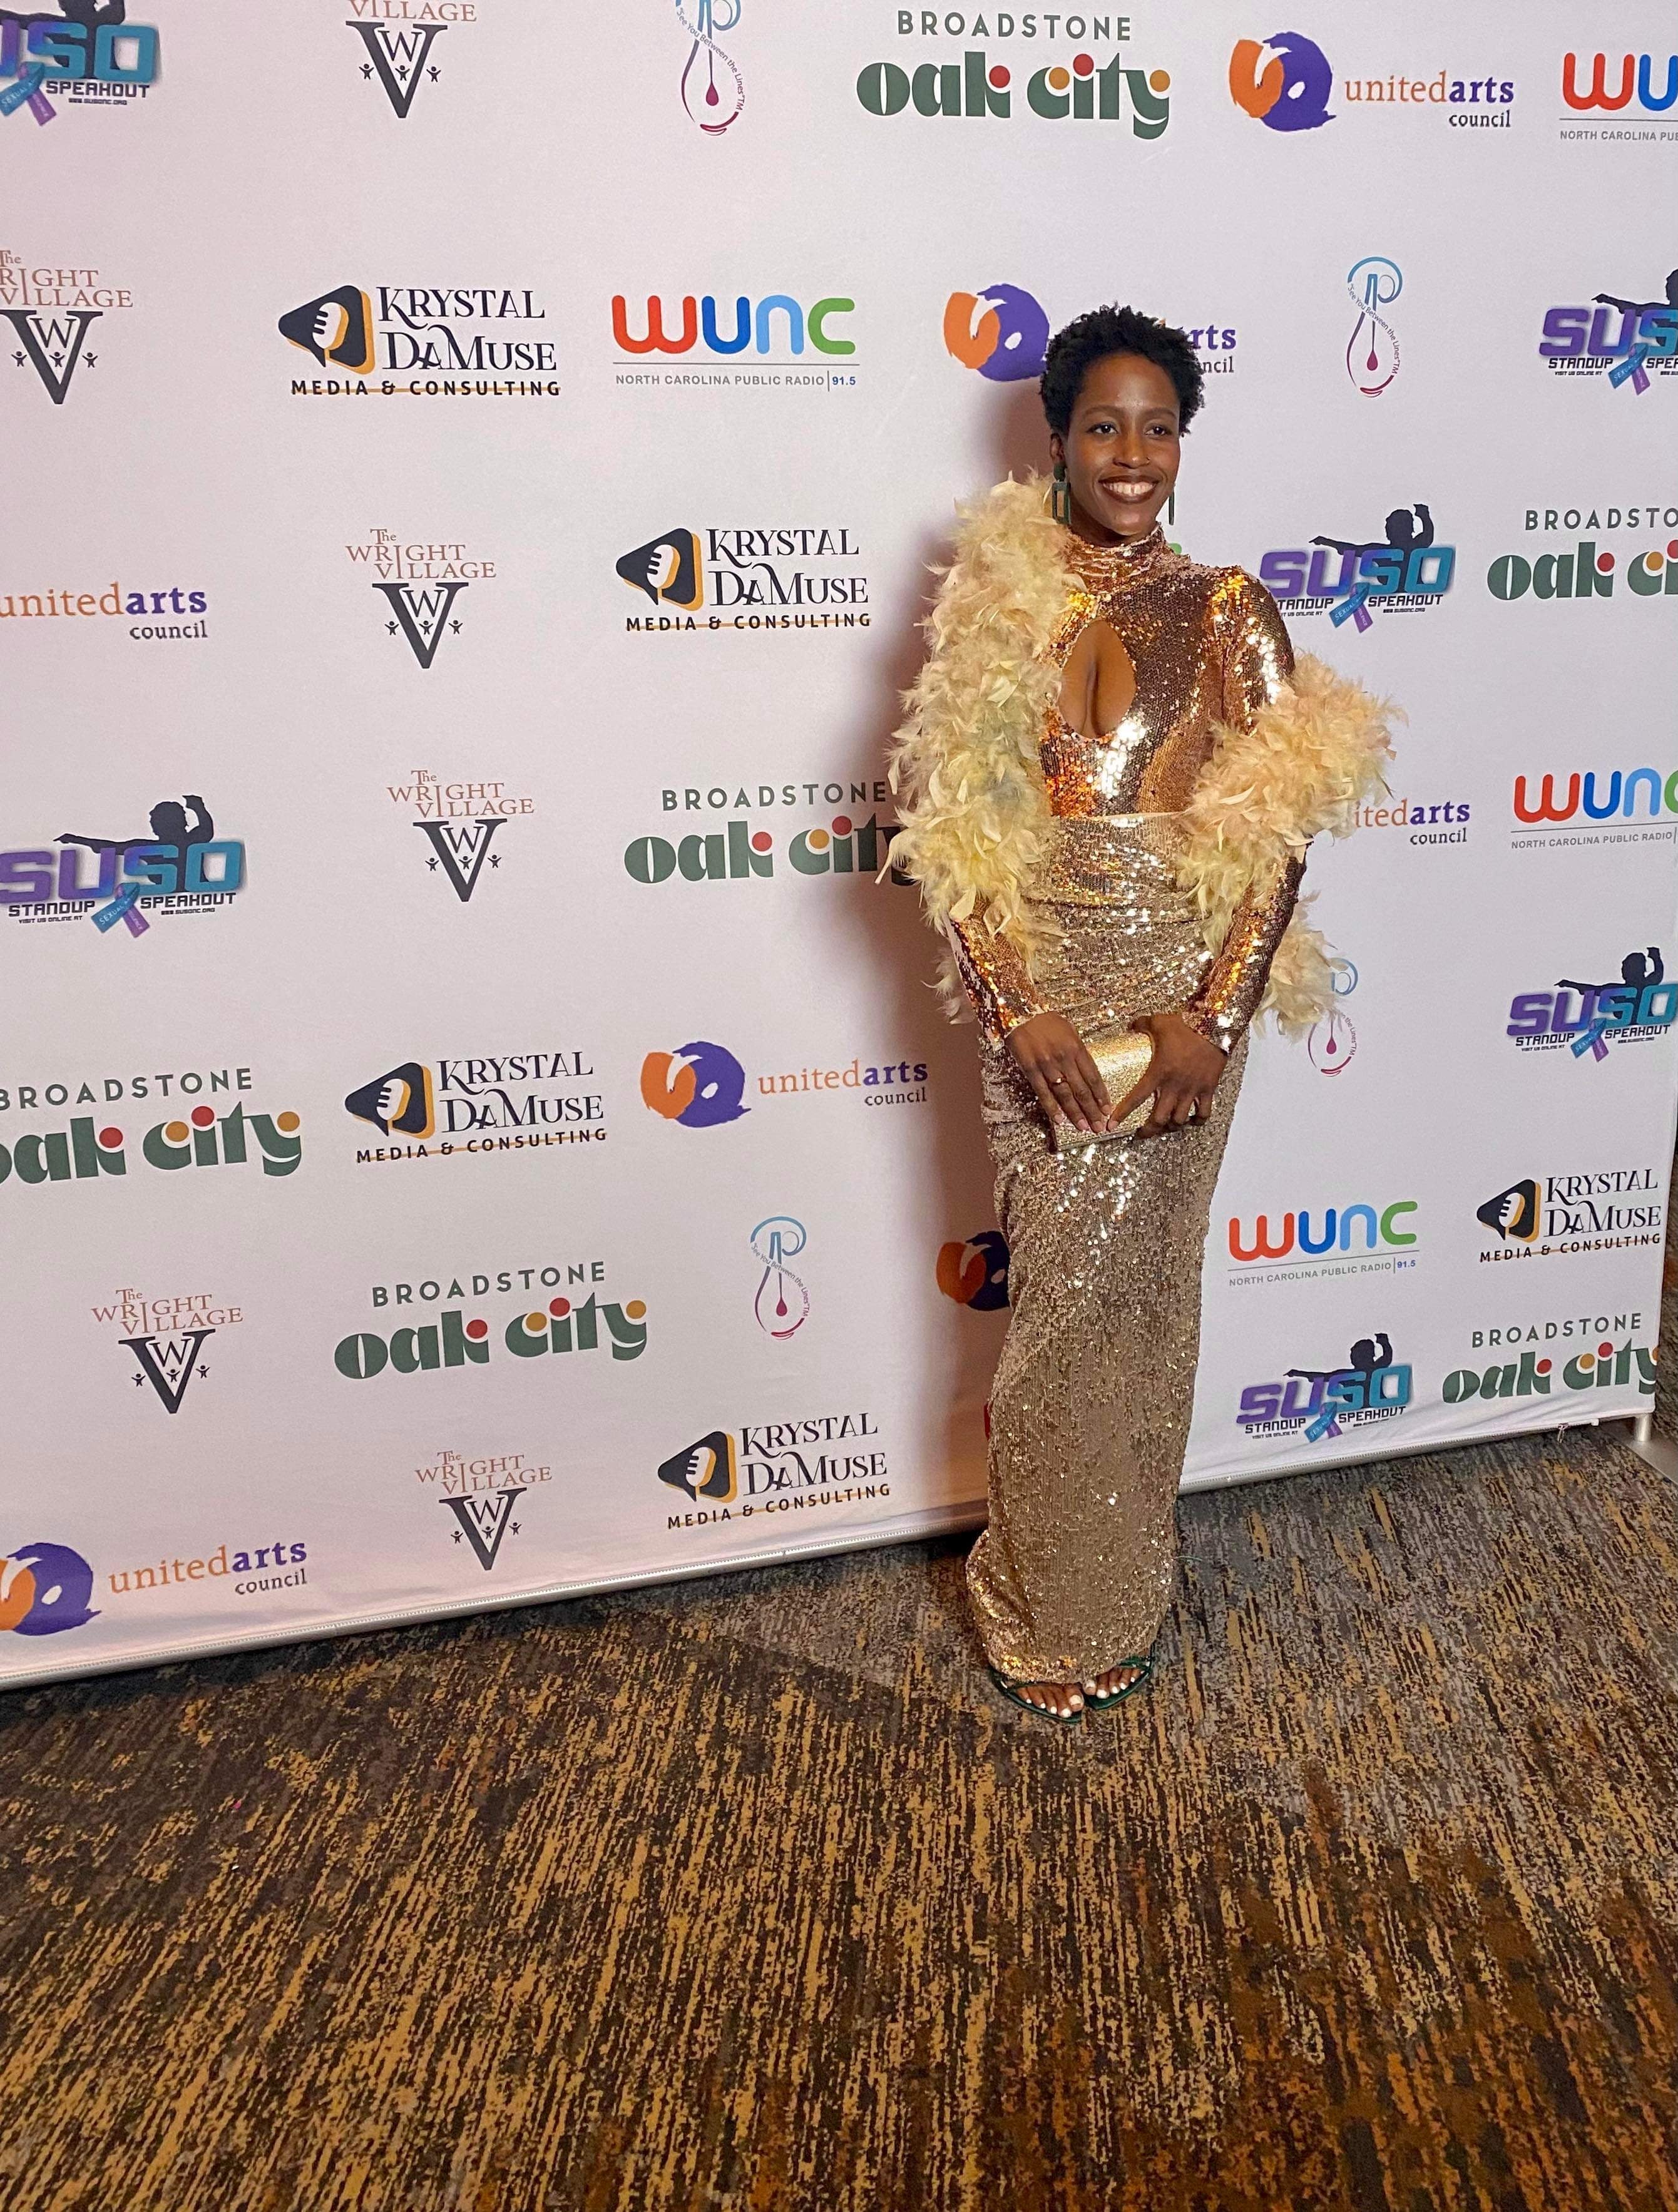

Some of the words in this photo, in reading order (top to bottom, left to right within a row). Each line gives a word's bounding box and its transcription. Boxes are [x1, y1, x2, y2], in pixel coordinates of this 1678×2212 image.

[350, 0, 477, 22] VILLAGE
[898, 9, 1131, 41] BROADSTONE
[687, 23, 700, 38] You
[700, 34, 729, 61] Between
[727, 59, 738, 73] the
[856, 51, 1011, 118] oak
[1026, 52, 1170, 140] city
[1448, 110, 1511, 128] council
[1560, 131, 1597, 141] NORTH
[1602, 131, 1656, 141] CAROLINA
[0, 287, 133, 307] VILLAGE
[376, 287, 545, 330] KRYSTAL
[1355, 297, 1365, 310] You
[1365, 306, 1389, 330] Between
[1387, 328, 1396, 341] the
[1548, 358, 1614, 369] STANDUP
[291, 380, 368, 396] MEDIA
[381, 381, 396, 394] &
[410, 380, 561, 396] CONSULTING
[616, 375, 660, 385] NORTH
[665, 376, 730, 385] CAROLINA
[735, 376, 781, 386] PUBLIC
[785, 376, 824, 386] RADIO
[832, 376, 856, 386] 91.5
[370, 529, 396, 545] The
[706, 529, 859, 568] KRYSTAL
[345, 545, 466, 562] WRIGHT
[374, 561, 496, 579] VILLAGE
[1260, 547, 1453, 597] SUSO
[1487, 541, 1615, 600] oak
[1277, 598, 1334, 611] TANDUP
[130, 620, 208, 640] council
[627, 617, 696, 631] MEDIA
[709, 616, 721, 630] &
[734, 613, 871, 629] CONSULTING
[386, 782, 504, 802] WRIGHT
[411, 770, 437, 786] The
[416, 798, 534, 818] VILLAGE
[662, 781, 886, 811] BROADSTONE
[1409, 827, 1467, 845] council
[1512, 839, 1545, 849] NORTH
[1549, 836, 1600, 847] CAROLINA
[1603, 834, 1639, 843] PUBLIC
[1642, 831, 1672, 841] RADIO
[624, 821, 773, 883] oak
[0, 841, 242, 904] SUSO
[9, 901, 95, 917] STANDUP
[1507, 983, 1678, 1036] SUSO
[1515, 1033, 1575, 1047] STANDUP
[1605, 1024, 1670, 1039] SPEAKOUT
[436, 1052, 593, 1095] KRYSTAL
[0, 1067, 252, 1111] BROADSTONE
[864, 1087, 928, 1106] council
[0, 1117, 126, 1184] ak
[143, 1101, 301, 1177] city
[356, 1144, 429, 1164] MEDIA
[441, 1142, 453, 1155] &
[467, 1128, 606, 1153] CONSULTING
[1545, 1169, 1659, 1206] KRYSTAL
[1480, 1247, 1532, 1263] MEDIA
[1541, 1245, 1550, 1256] &
[1560, 1233, 1660, 1254] CONSULTING
[372, 1261, 605, 1307] BROADSTONE
[1229, 1276, 1264, 1287] NORTH
[1267, 1271, 1317, 1283] CAROLINA
[1321, 1266, 1357, 1276] PUBLIC
[1361, 1262, 1391, 1272] RADIO
[1396, 1260, 1416, 1268] 91.5
[91, 1294, 212, 1323] WRIGHT
[116, 1288, 143, 1304] The
[120, 1308, 243, 1335] VILLAGE
[334, 1310, 490, 1379] oak
[504, 1292, 647, 1361] city
[1472, 1313, 1641, 1348] BROADSTONE
[1442, 1351, 1552, 1403] oak
[1236, 1365, 1412, 1424] SUSO
[739, 1413, 878, 1458] KRYSTAL
[1245, 1418, 1306, 1433] STANDUP
[414, 1455, 524, 1483] WRIGHT
[437, 1450, 461, 1465] The
[441, 1467, 552, 1495] VILLAGE
[668, 1508, 731, 1529] MEDIA
[742, 1505, 754, 1517] &
[765, 1483, 890, 1513] CONSULTING
[235, 1569, 308, 1595] council
